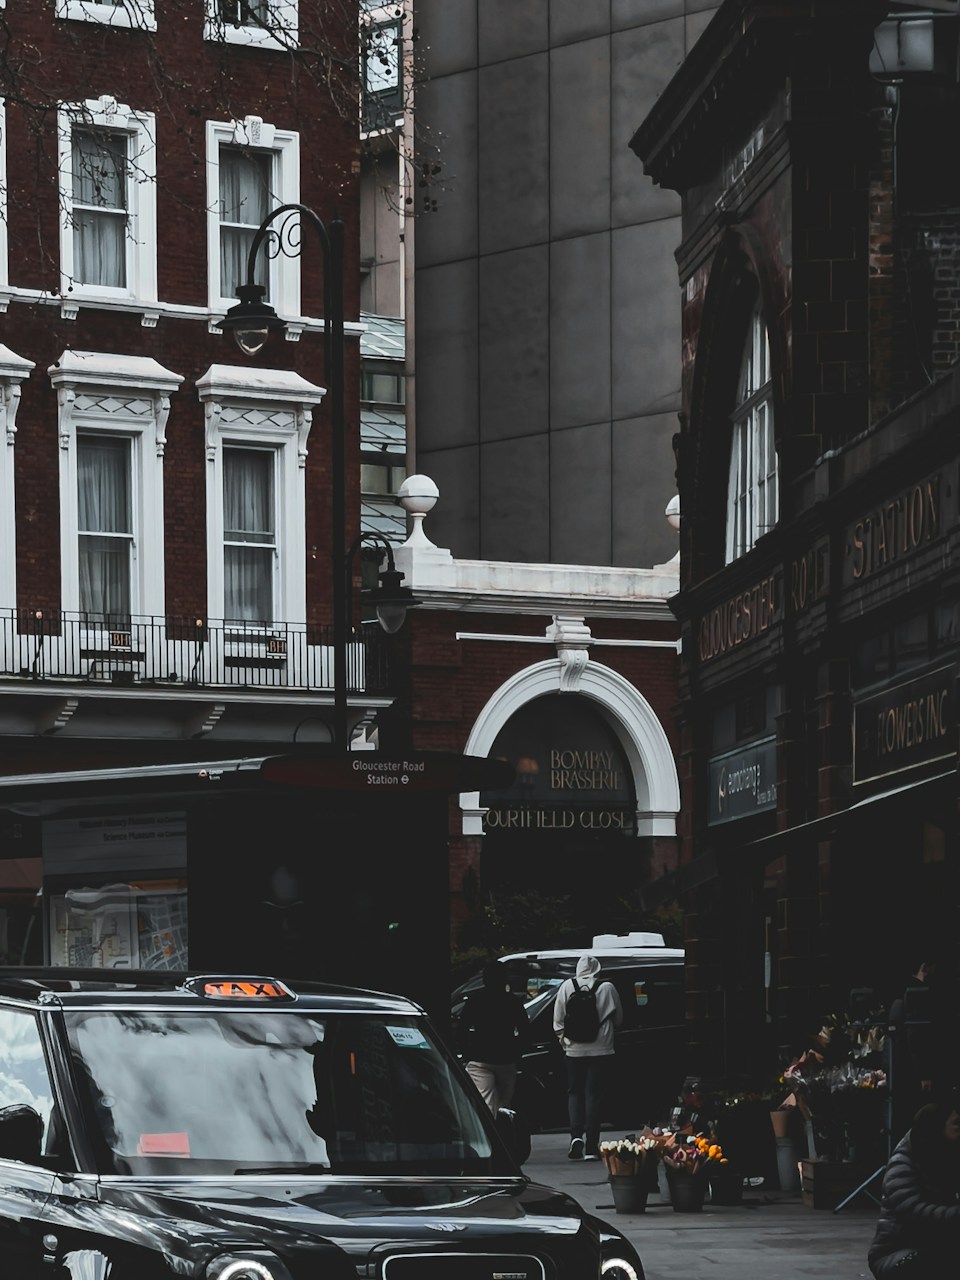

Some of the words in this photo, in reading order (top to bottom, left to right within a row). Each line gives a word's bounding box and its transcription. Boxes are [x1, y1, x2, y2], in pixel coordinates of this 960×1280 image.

[697, 576, 776, 662] GLOUCESTER
[852, 477, 940, 579] STATION
[113, 633, 129, 646] BH
[269, 640, 285, 653] BH
[877, 697, 924, 757] FLOWERS
[926, 689, 948, 741] INC
[352, 759, 401, 772] Gloucester
[402, 761, 425, 772] Road
[551, 749, 615, 770] BOMBAY
[367, 774, 398, 785] Station
[551, 769, 624, 790] BRASSERIE
[483, 808, 575, 829] OURTFIELD
[210, 983, 281, 997] TAXI
